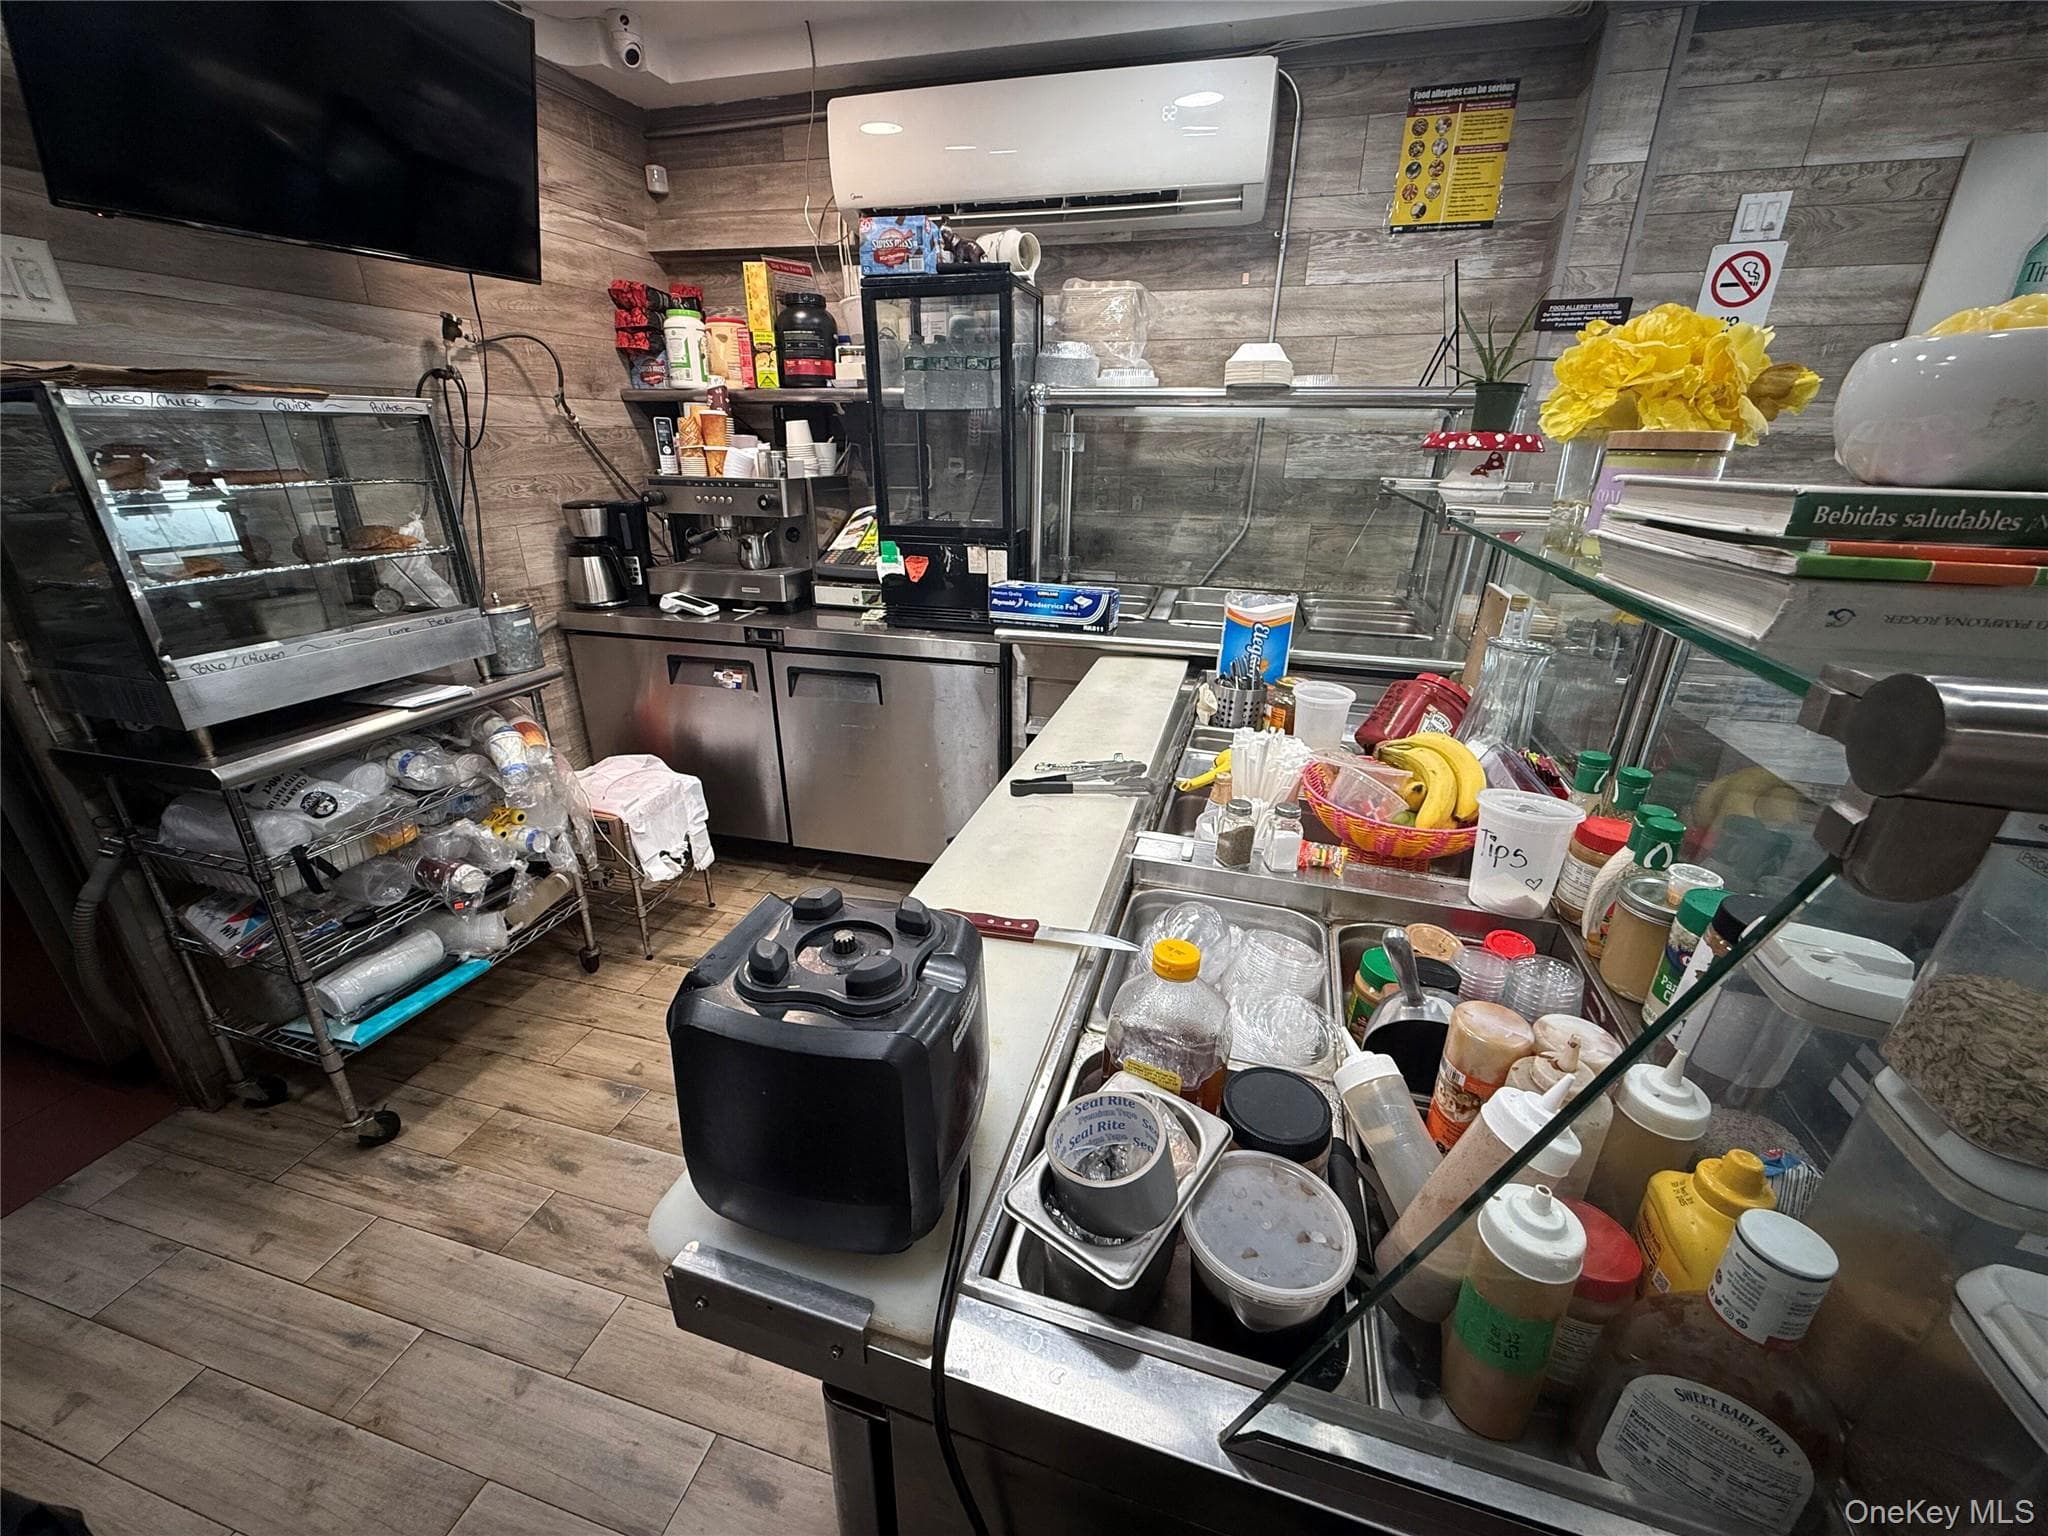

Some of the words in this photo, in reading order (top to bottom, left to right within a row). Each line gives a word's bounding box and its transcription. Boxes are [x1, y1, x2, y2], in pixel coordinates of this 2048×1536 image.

[1414, 89, 1431, 99] Food
[1432, 88, 1462, 98] allergies
[1463, 86, 1477, 95] can
[1478, 84, 1487, 94] be
[1488, 82, 1516, 92] serious
[1813, 506, 1898, 527] Bebidas
[1902, 508, 2024, 532] saludables
[1024, 601, 1064, 610] Foodservice
[1065, 603, 1078, 611] Foil
[1884, 614, 1940, 626] ROGER
[1480, 828, 1528, 868] Tips
[1074, 1096, 1103, 1115] Seal
[1108, 1096, 1136, 1109] Rite
[1069, 1124, 1093, 1150] Seal
[1097, 1121, 1126, 1132] Rite
[1674, 1387, 1718, 1408] SWEET
[1720, 1402, 1758, 1430] BABY
[1691, 1414, 1757, 1454] ORIGINAL
